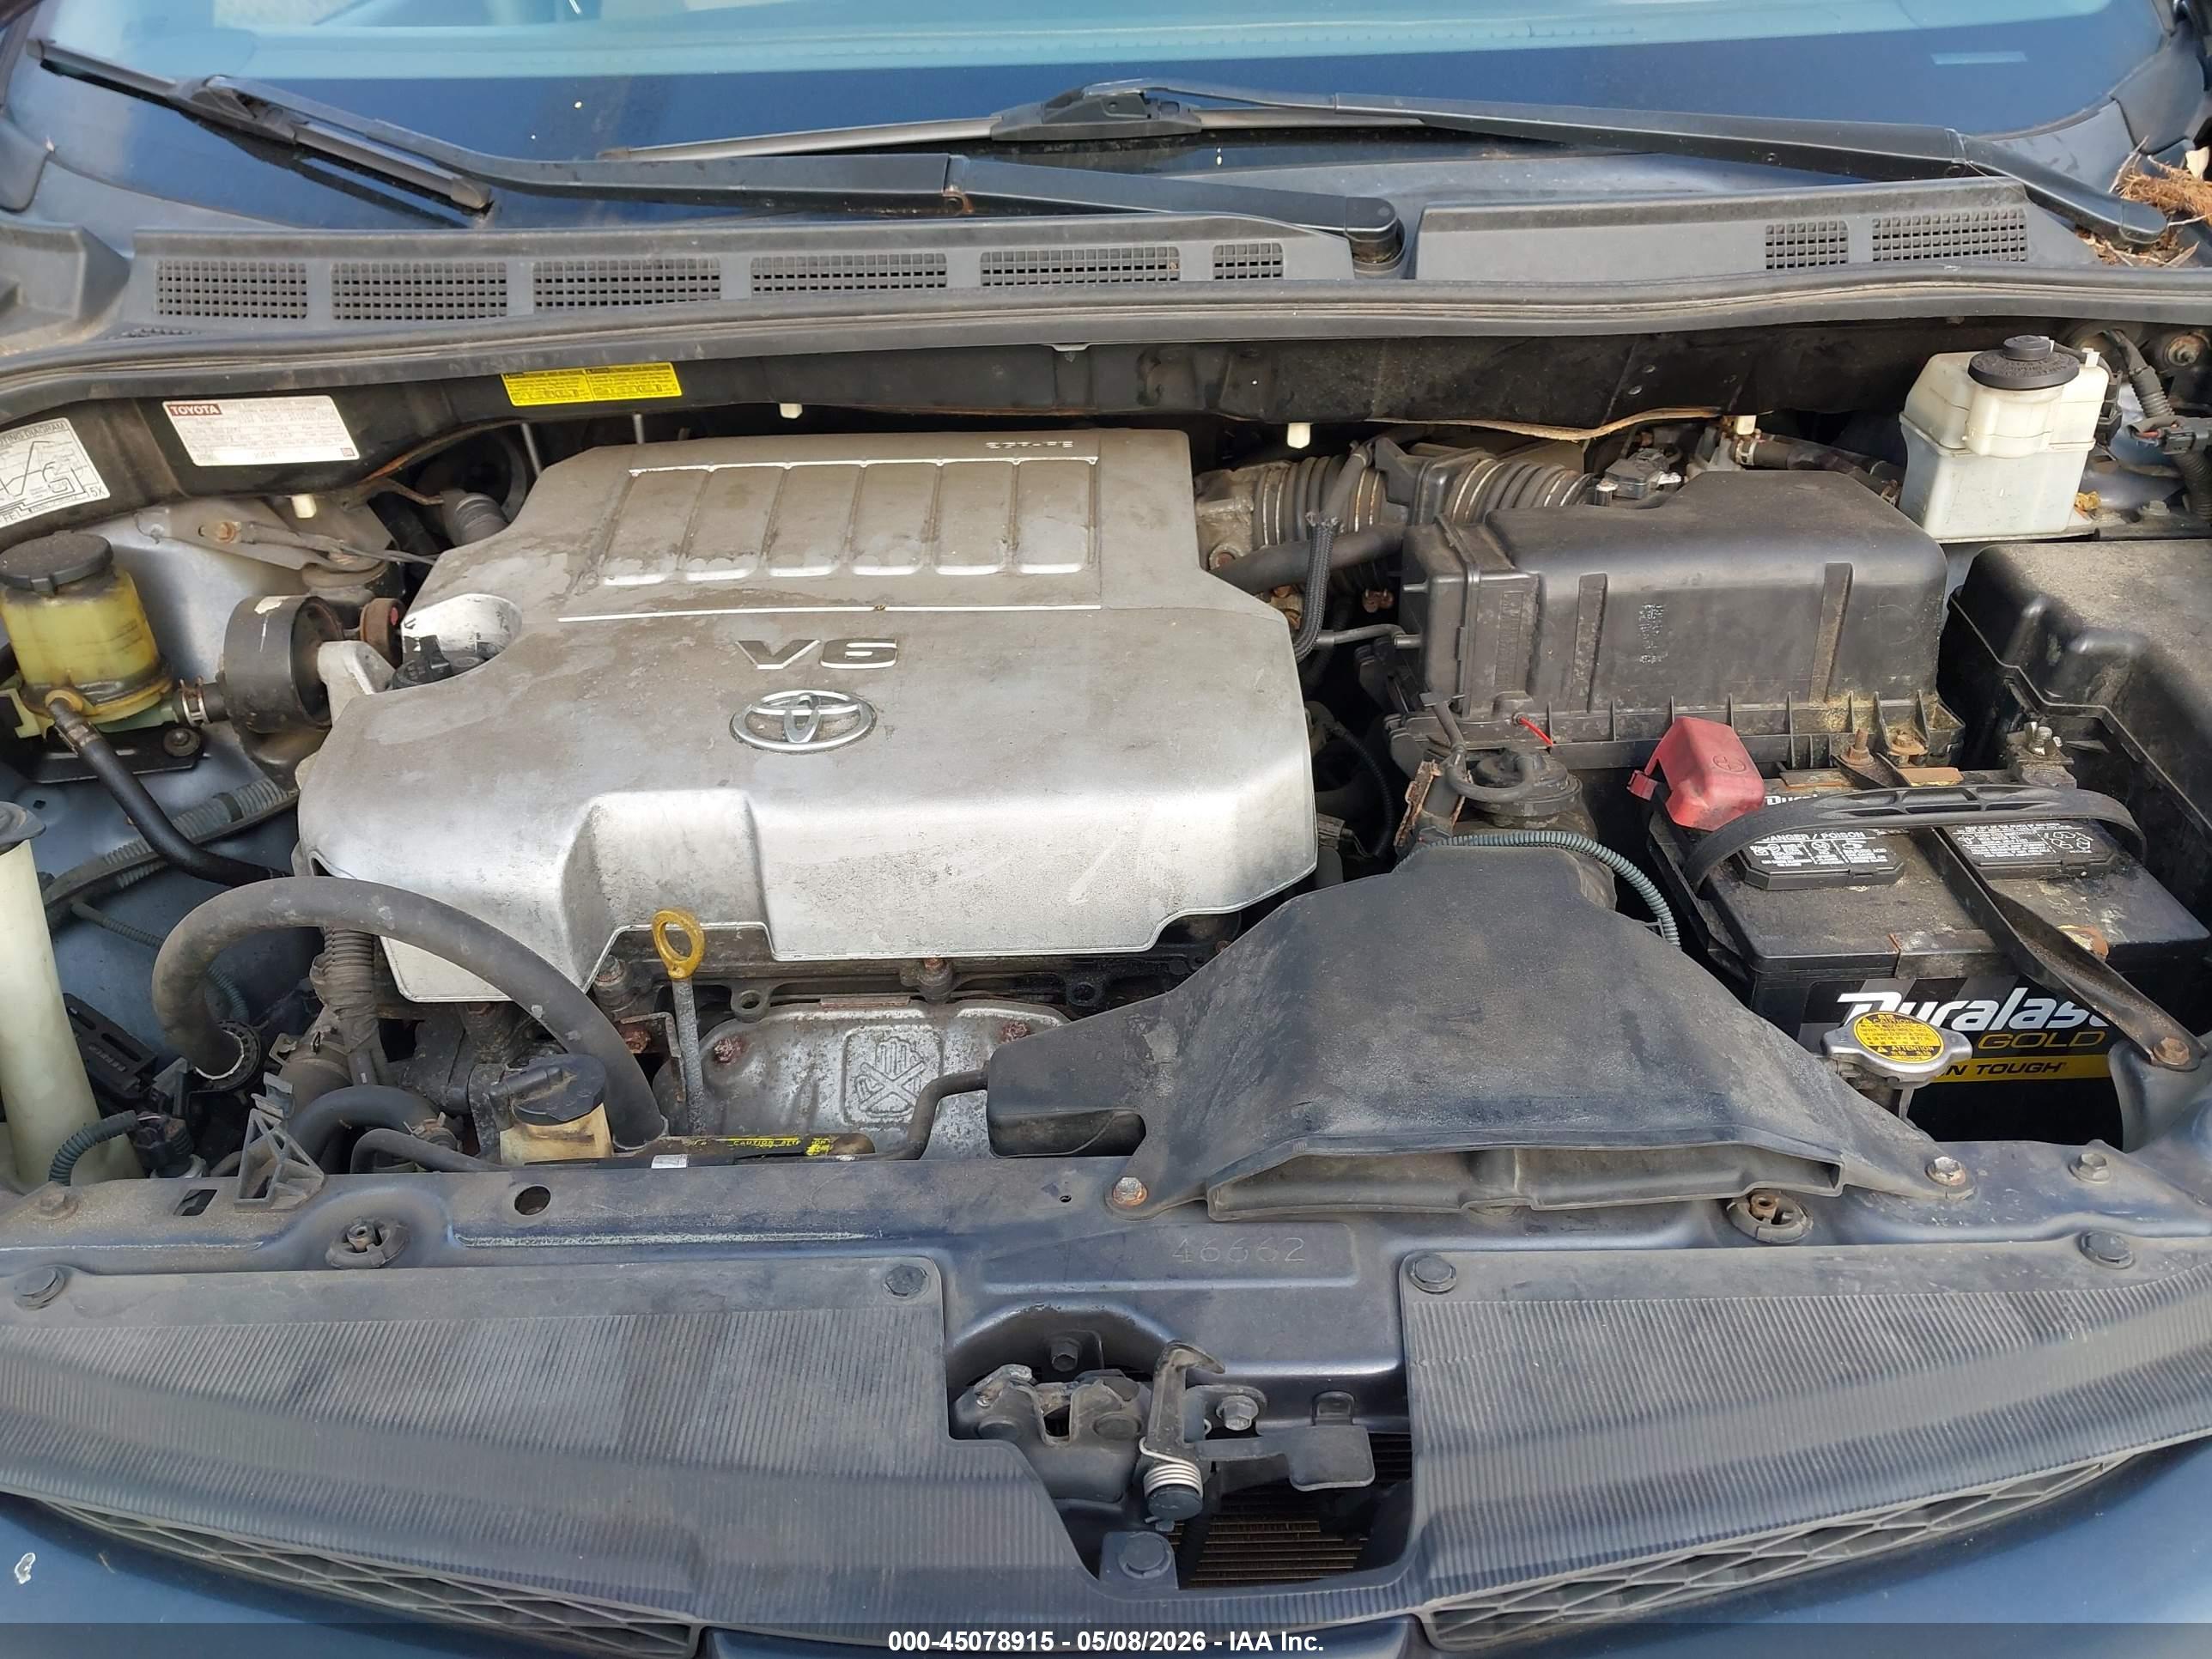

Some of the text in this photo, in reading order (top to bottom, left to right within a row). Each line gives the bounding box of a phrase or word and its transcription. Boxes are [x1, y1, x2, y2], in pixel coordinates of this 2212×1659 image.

[170, 404, 221, 415] TOYOTA
[90, 487, 106, 497] 5X
[735, 639, 897, 669] V6
[1820, 831, 1866, 841] POISON
[1837, 988, 2109, 1030] Duralas
[1978, 1031, 2106, 1049] GOLD
[1977, 1062, 2062, 1075] TOUGH
[1172, 1237, 1305, 1262] 46662
